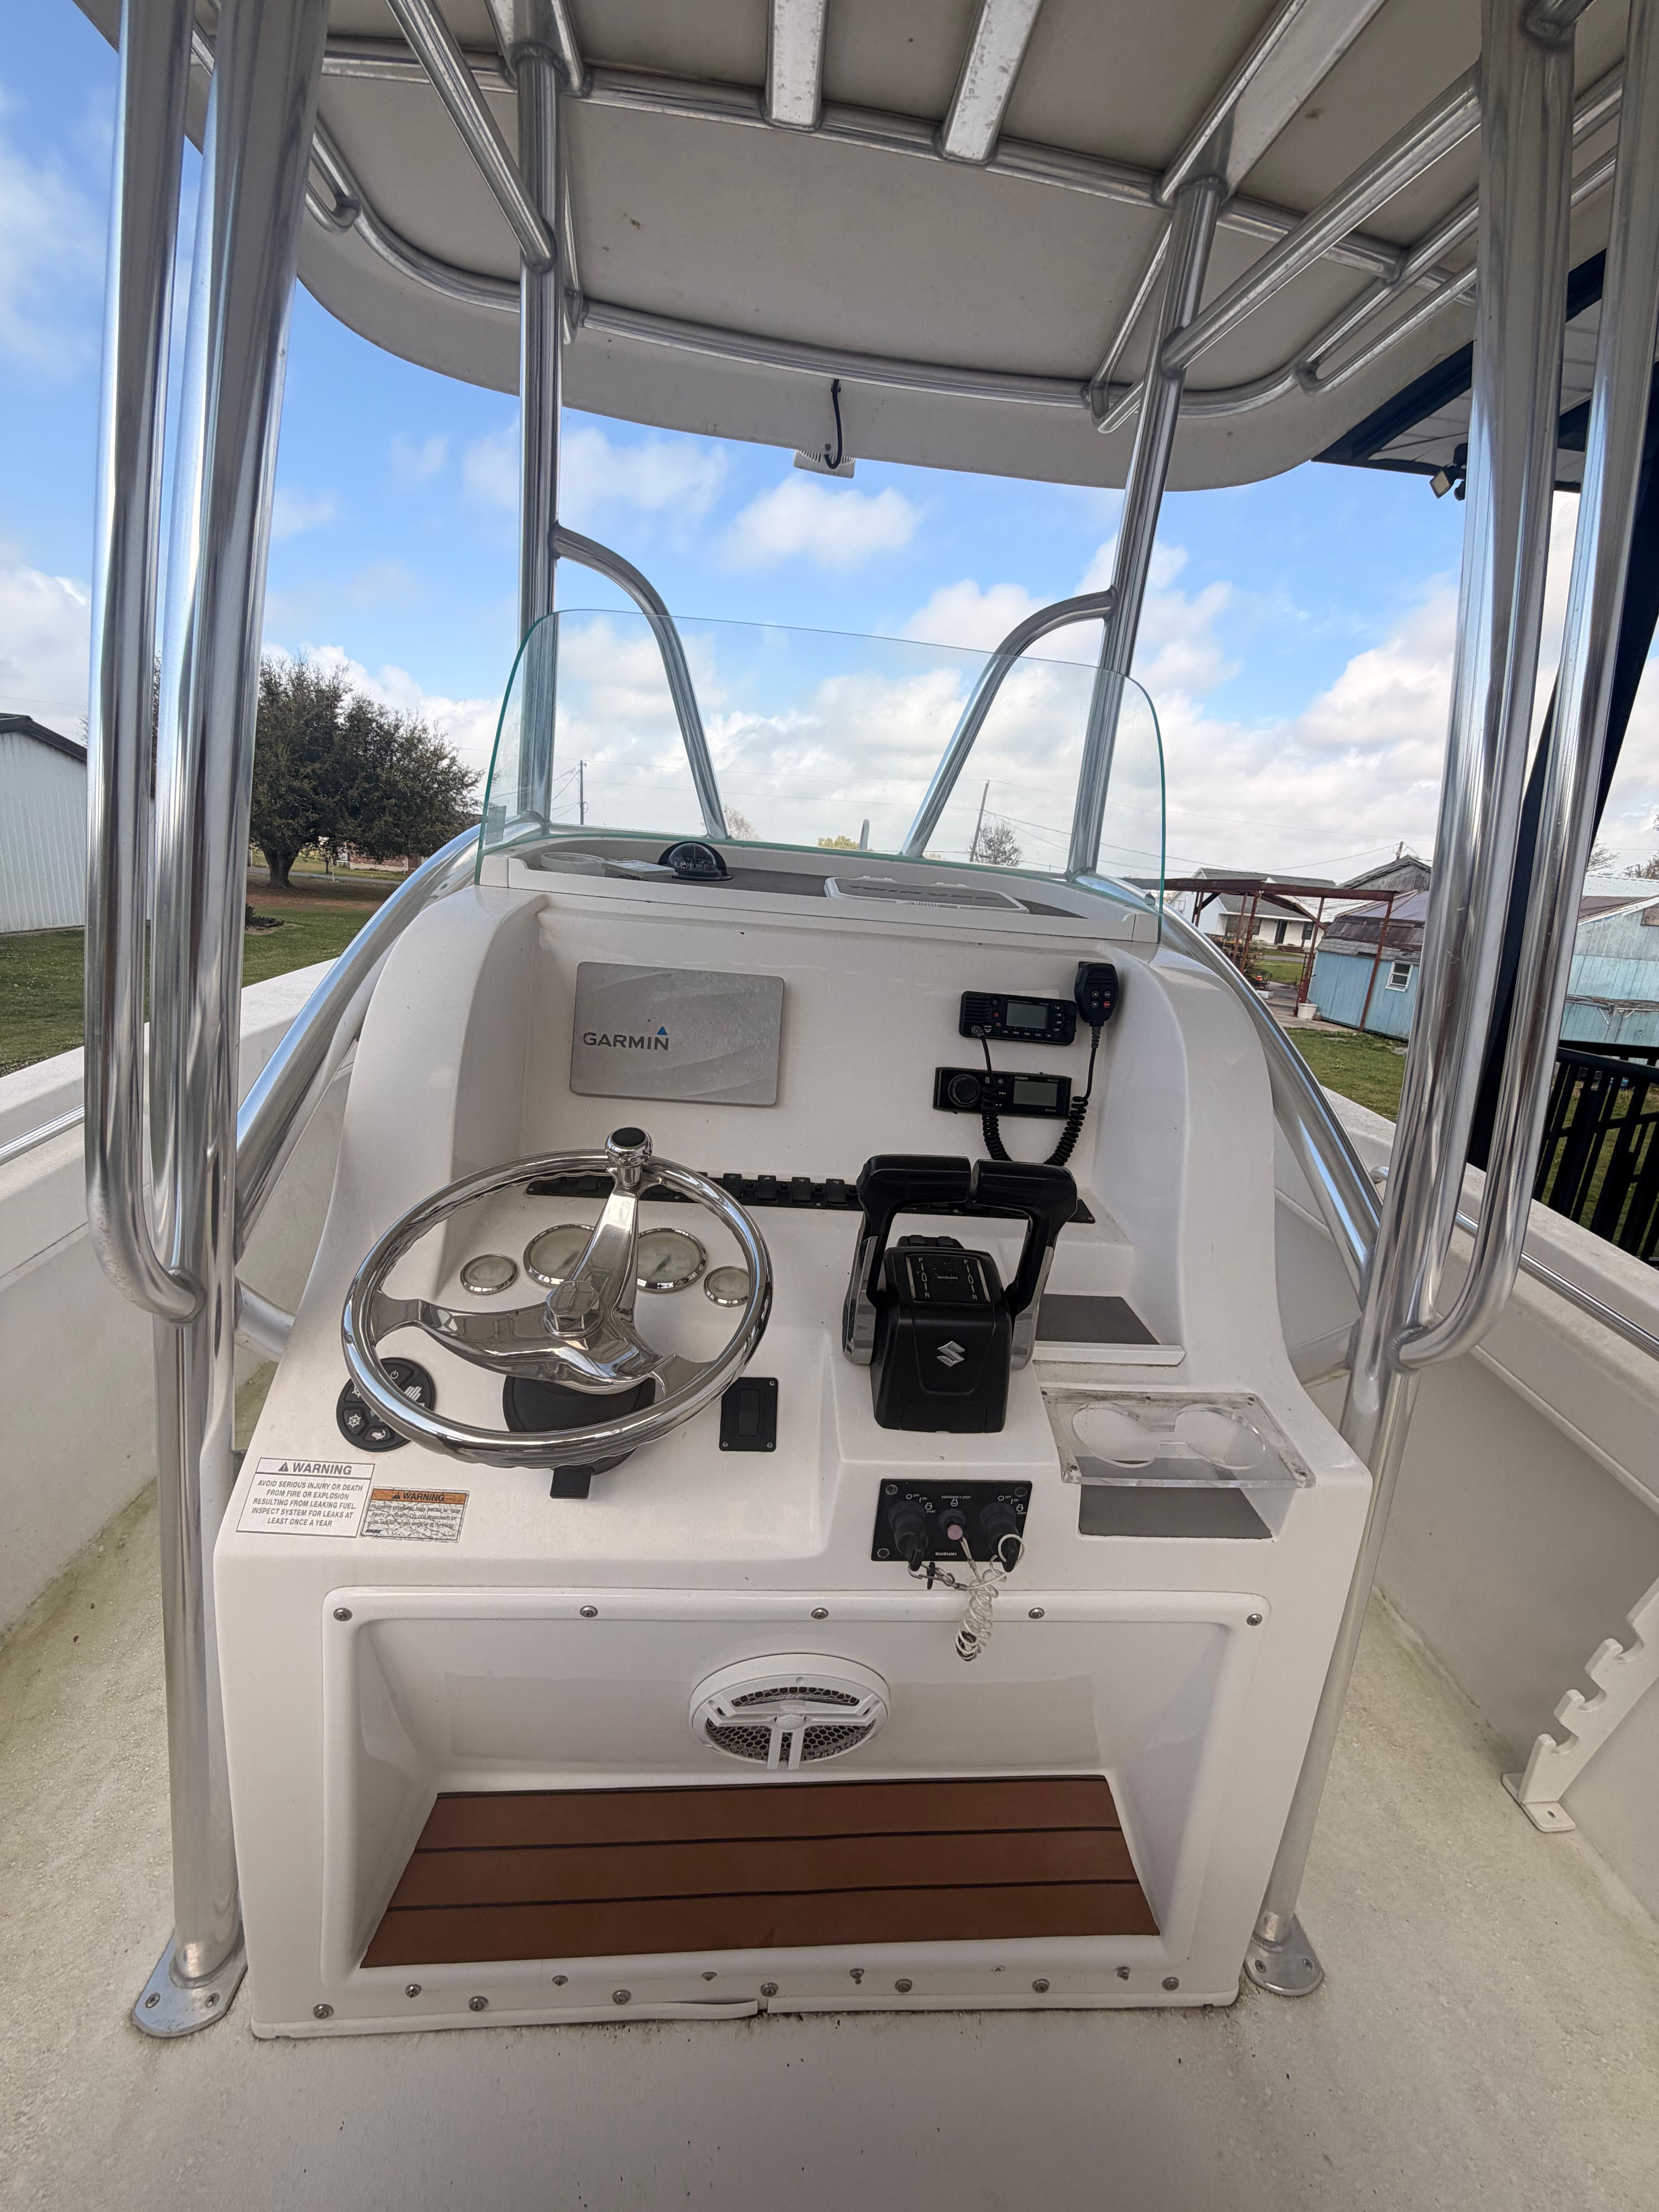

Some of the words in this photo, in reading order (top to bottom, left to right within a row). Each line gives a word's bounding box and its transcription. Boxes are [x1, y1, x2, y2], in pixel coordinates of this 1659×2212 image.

[584, 1032, 669, 1051] GARMIN
[293, 1462, 352, 1475] WARNING
[313, 1492, 349, 1500] EXPLOSION
[403, 1492, 445, 1501] WARNING
